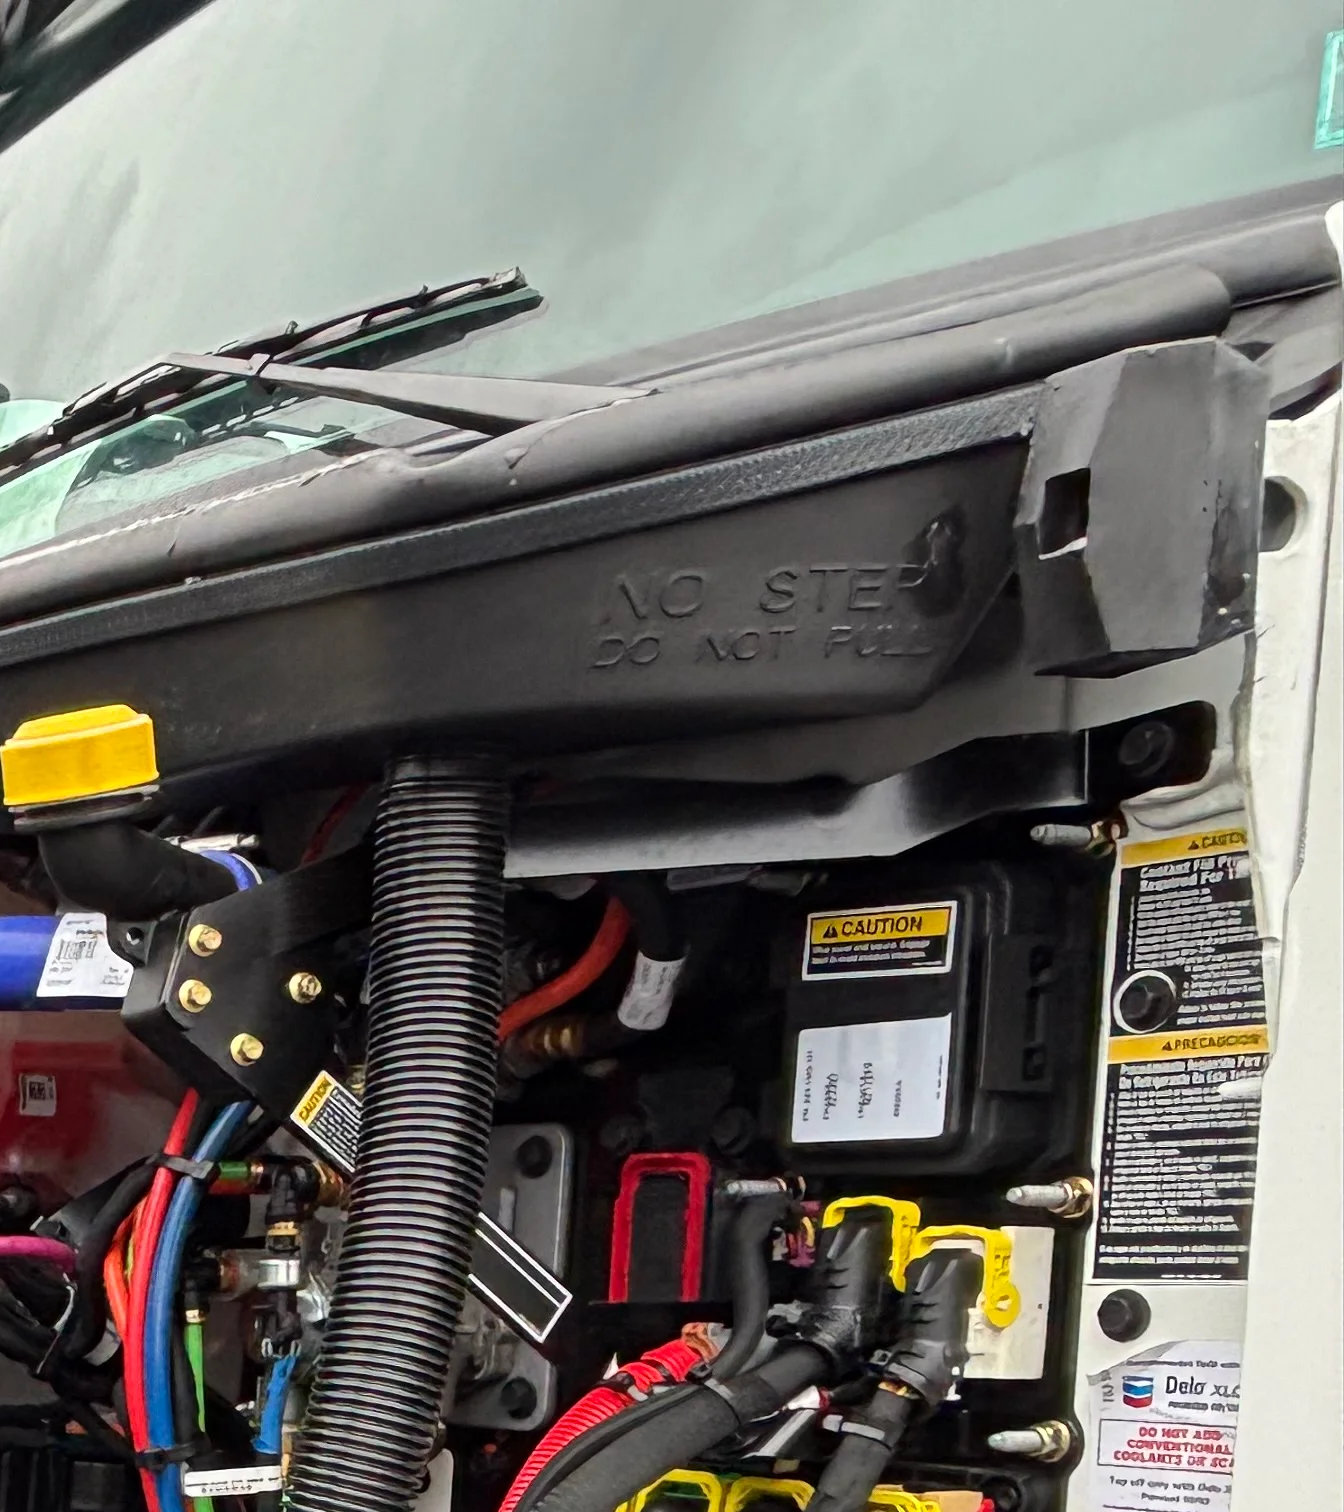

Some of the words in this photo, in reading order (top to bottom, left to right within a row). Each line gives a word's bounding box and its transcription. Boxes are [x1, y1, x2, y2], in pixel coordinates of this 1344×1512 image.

[600, 567, 705, 622] NO
[759, 561, 934, 614] STEP
[588, 633, 662, 668] DO
[695, 624, 799, 662] NOT
[841, 915, 924, 937] CAUTION
[1165, 1375, 1207, 1396] Delo
[1139, 1427, 1158, 1438] DO
[1161, 1428, 1189, 1439] NOT
[1114, 1450, 1183, 1466] COOLANTS
